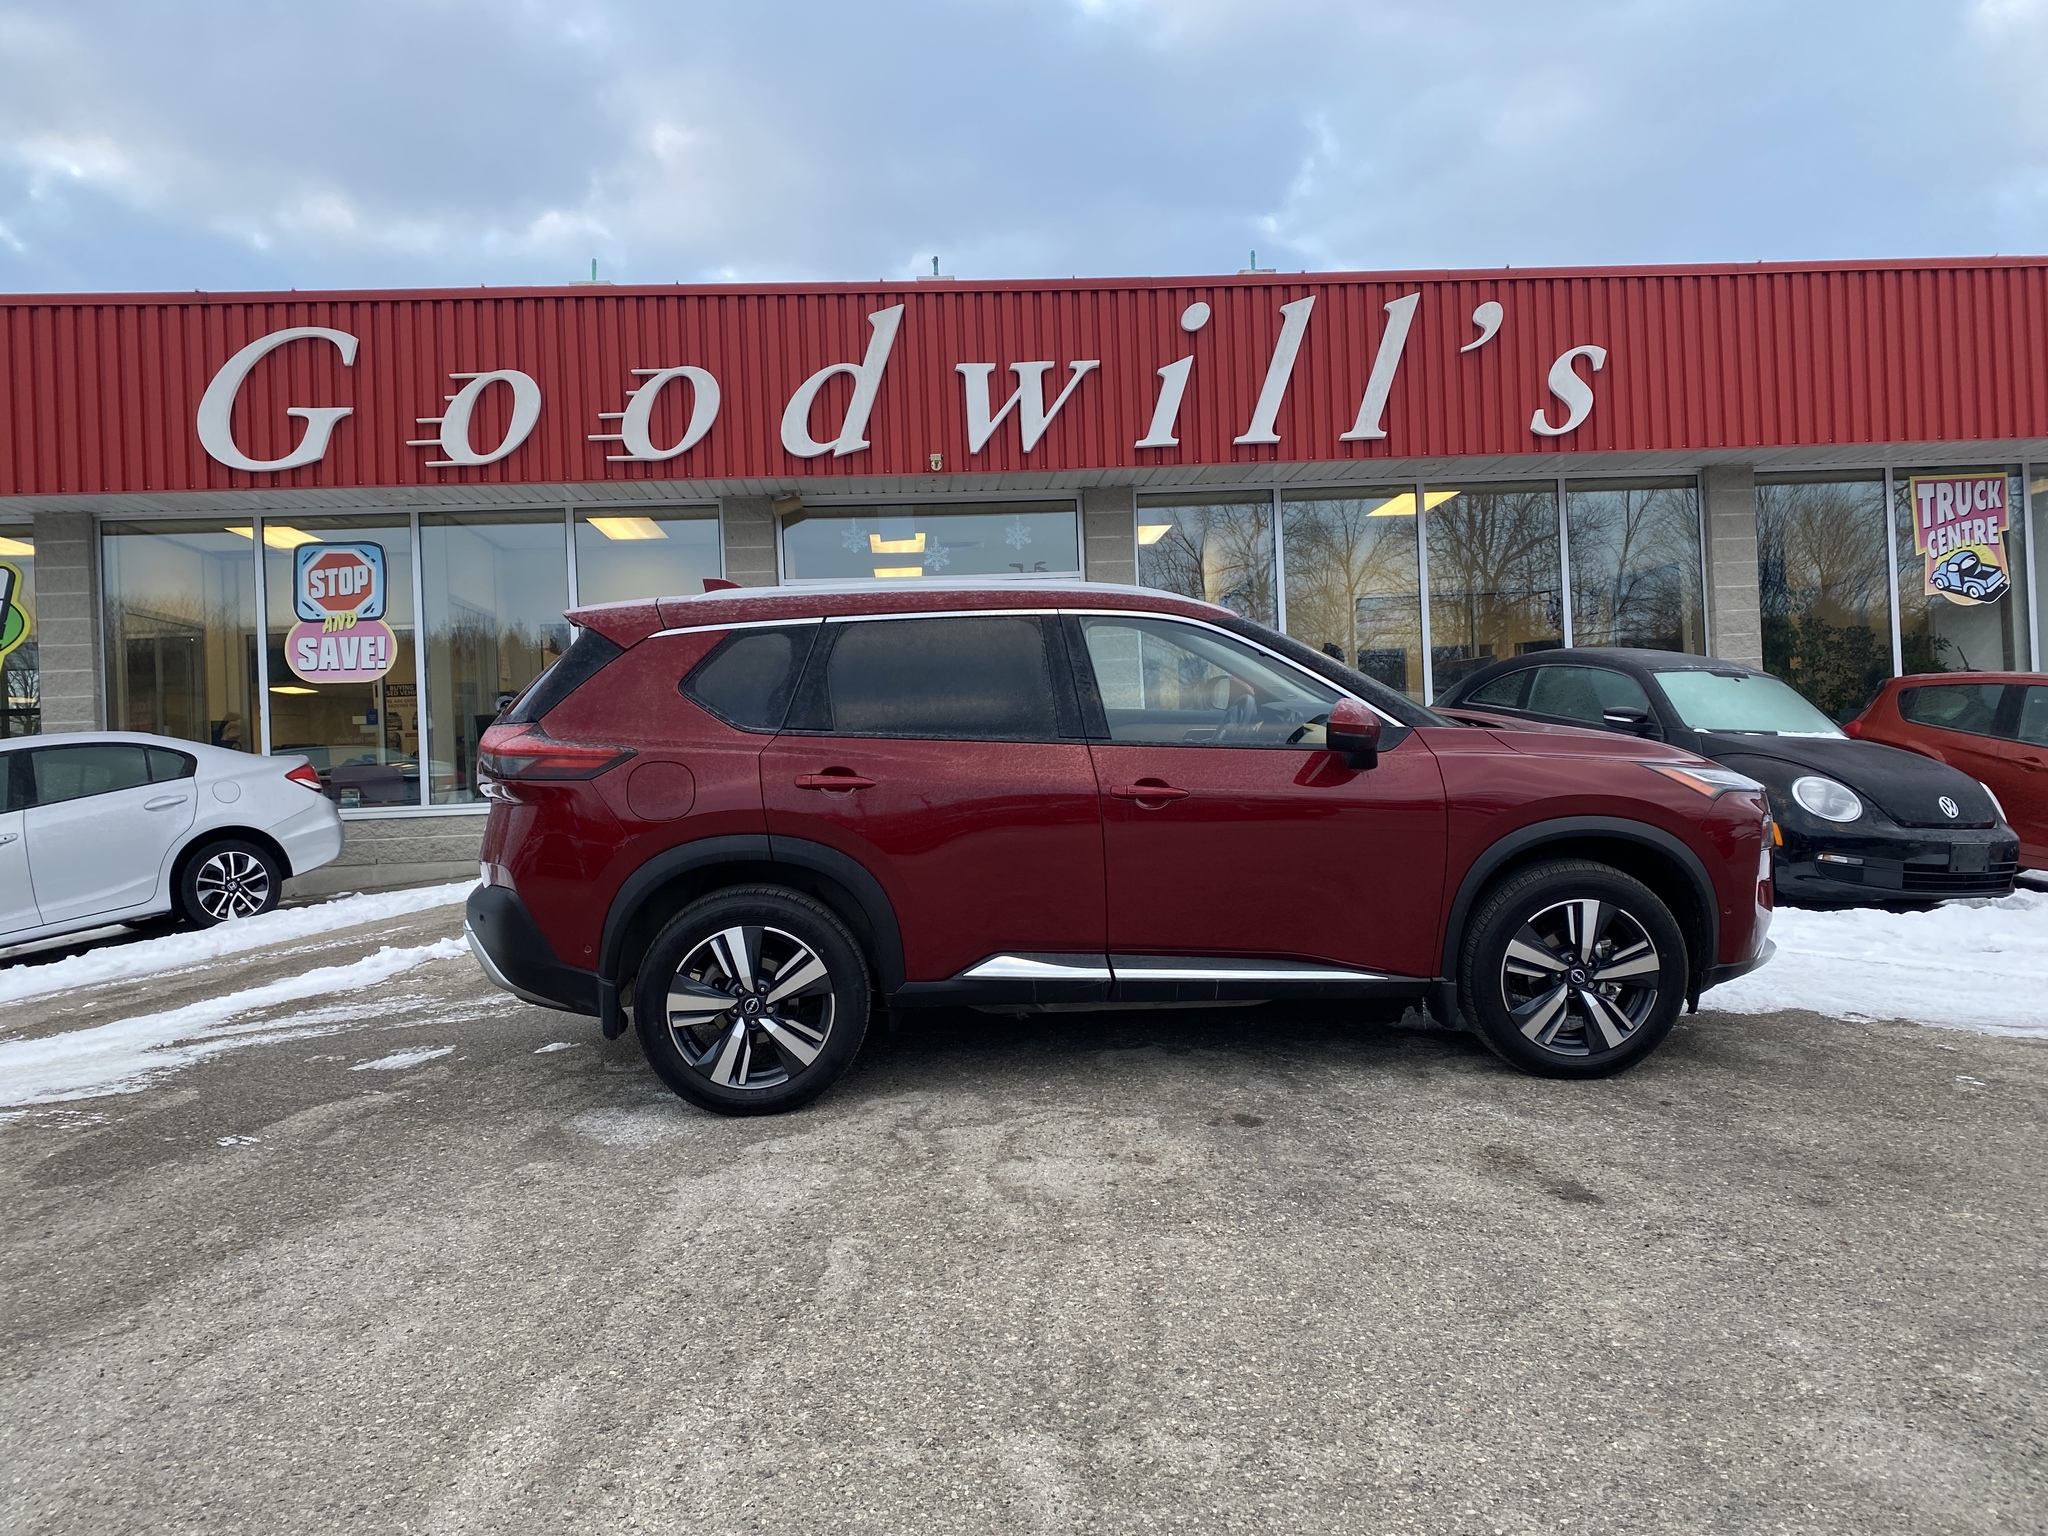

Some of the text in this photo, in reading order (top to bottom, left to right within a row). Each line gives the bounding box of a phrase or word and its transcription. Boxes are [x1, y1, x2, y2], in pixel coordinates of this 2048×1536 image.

[196, 291, 1607, 473] Goodwill's
[1917, 480, 2002, 529] TRUCK
[1926, 515, 2000, 559] CENTRE
[310, 565, 369, 599] STOP
[322, 610, 358, 634] AND
[297, 635, 387, 672] SAVE!
